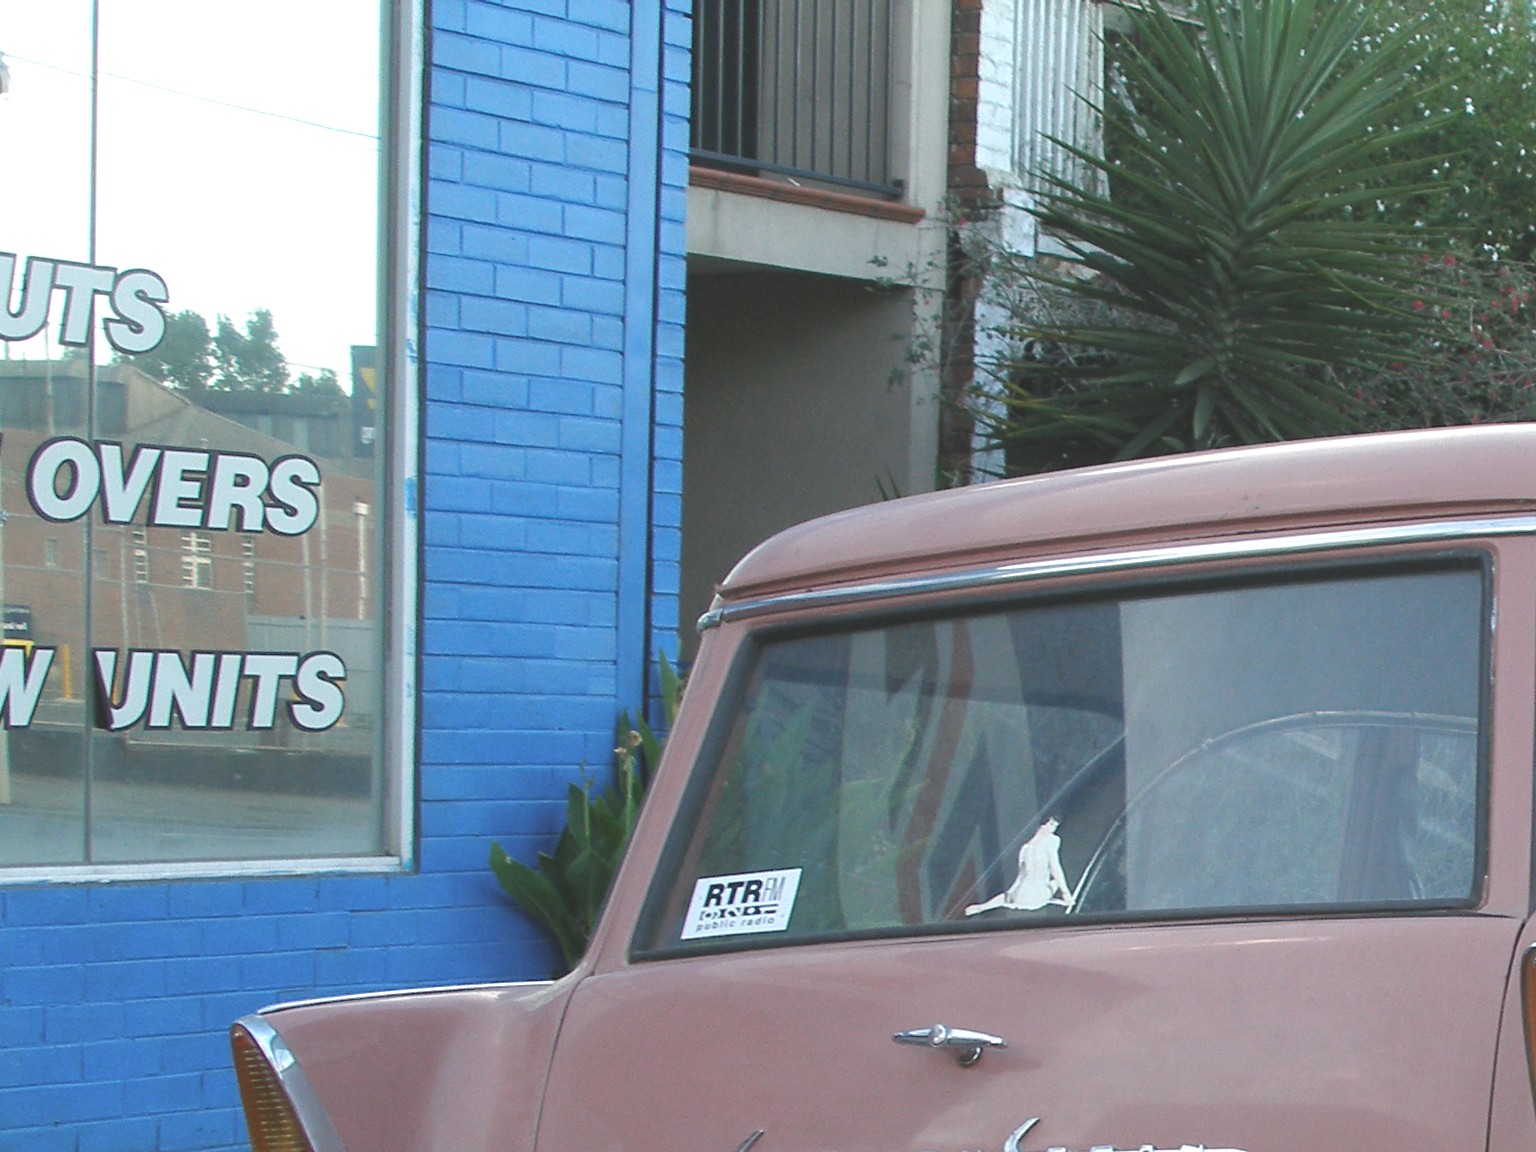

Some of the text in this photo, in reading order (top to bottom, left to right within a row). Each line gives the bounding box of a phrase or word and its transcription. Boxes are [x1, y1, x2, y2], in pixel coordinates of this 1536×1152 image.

[28, 437, 321, 536] OVERS
[94, 647, 347, 734] UNITS
[696, 917, 775, 932] public radio
